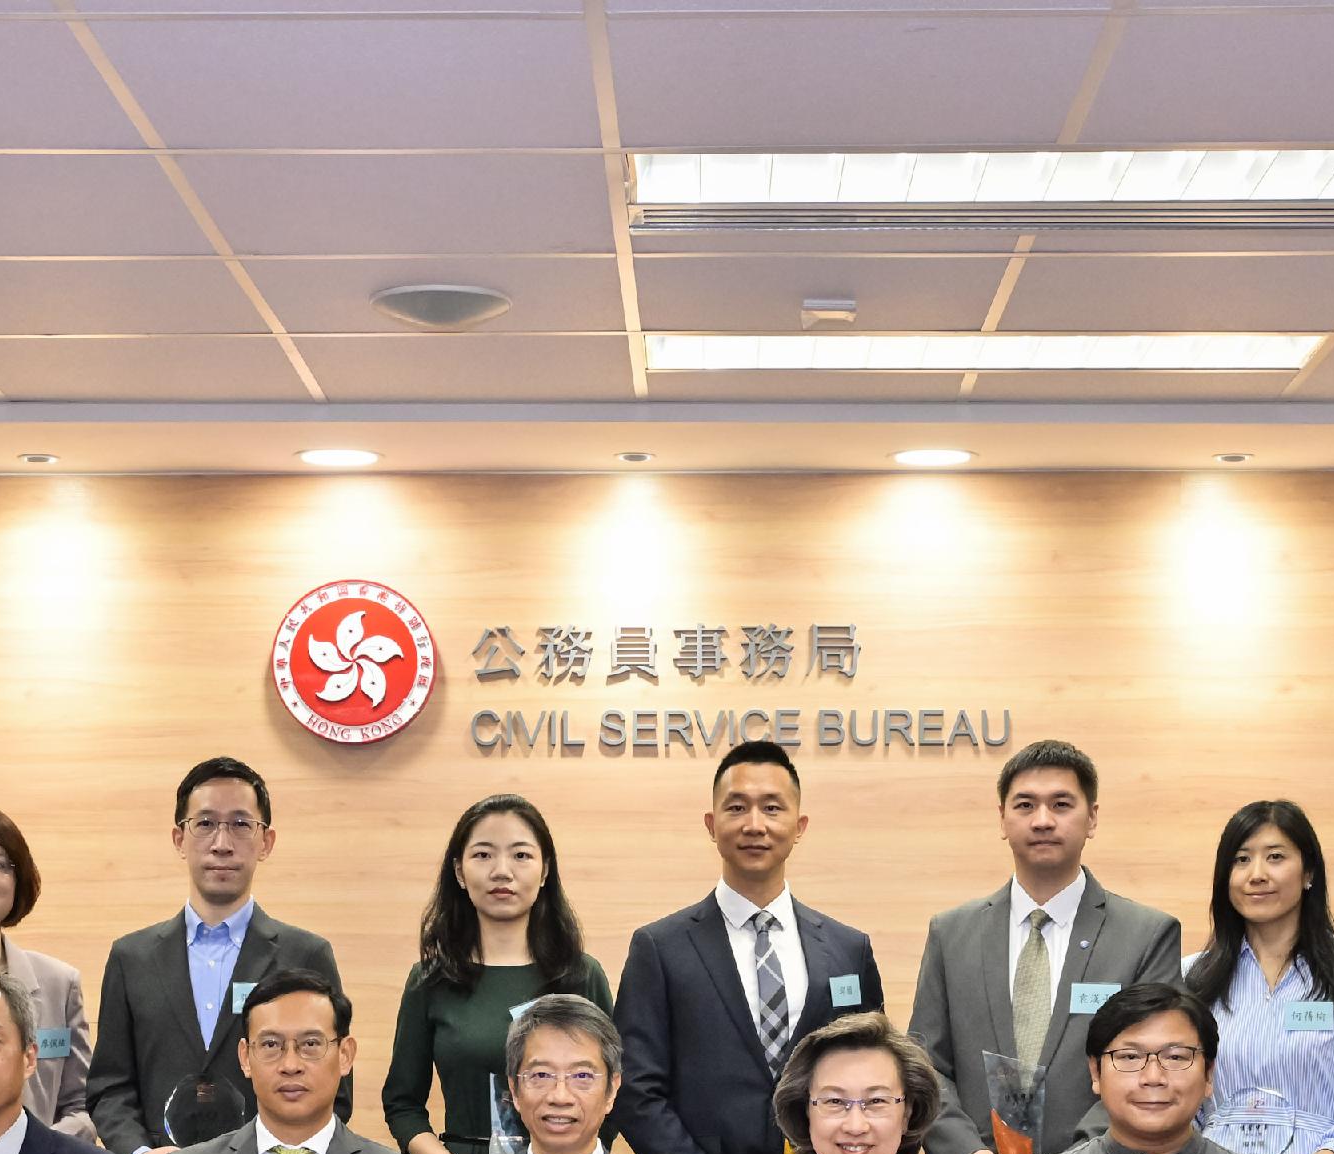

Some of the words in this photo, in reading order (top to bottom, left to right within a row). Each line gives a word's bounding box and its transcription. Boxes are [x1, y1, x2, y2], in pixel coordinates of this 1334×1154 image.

[471, 623, 861, 679] 公務員事務局
[306, 714, 352, 741] HONG
[361, 714, 403, 740] KONG
[471, 709, 585, 748] CIVIL
[600, 709, 801, 748] SERVICE
[818, 709, 1011, 748] BUREAU
